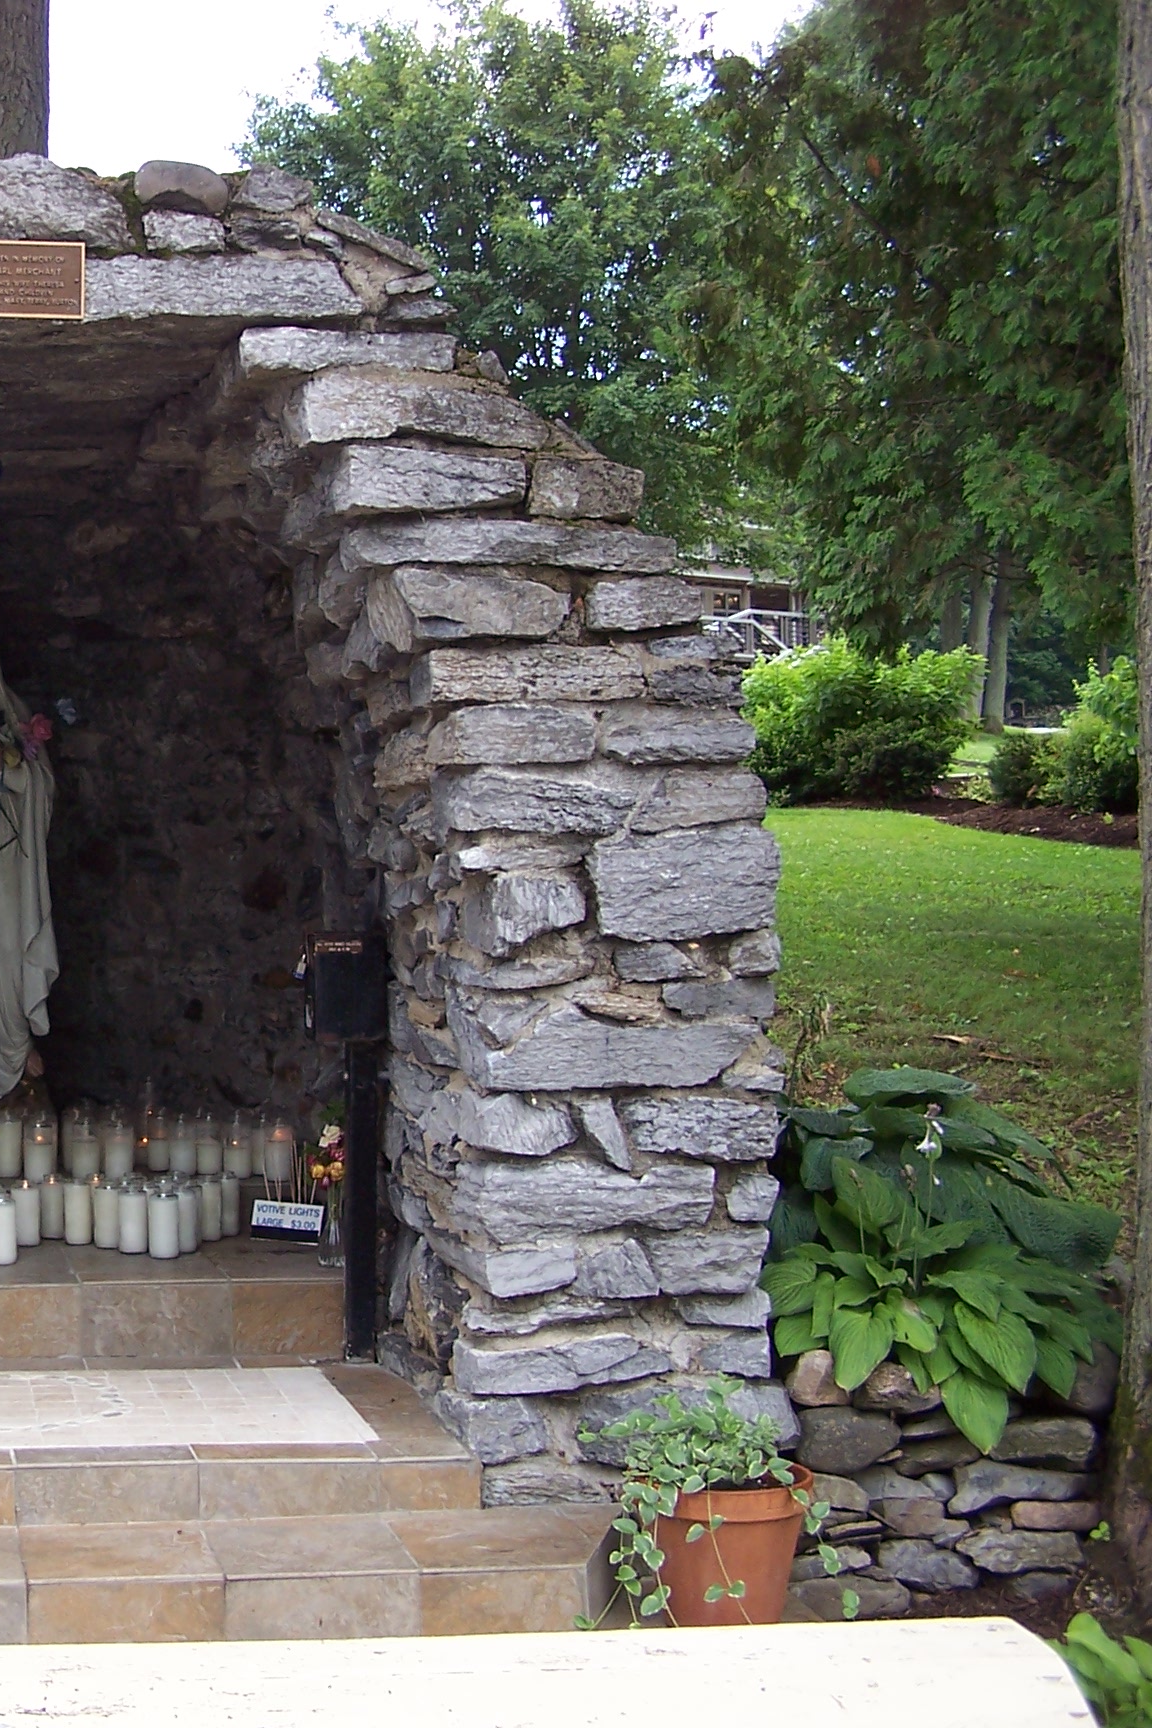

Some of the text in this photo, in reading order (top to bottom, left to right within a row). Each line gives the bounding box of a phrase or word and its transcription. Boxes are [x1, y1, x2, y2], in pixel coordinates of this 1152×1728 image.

[16, 267, 61, 276] MERCHANT
[256, 1204, 320, 1218] VOTIVE LIGHTS
[256, 1217, 316, 1230] LARGE $3.00
